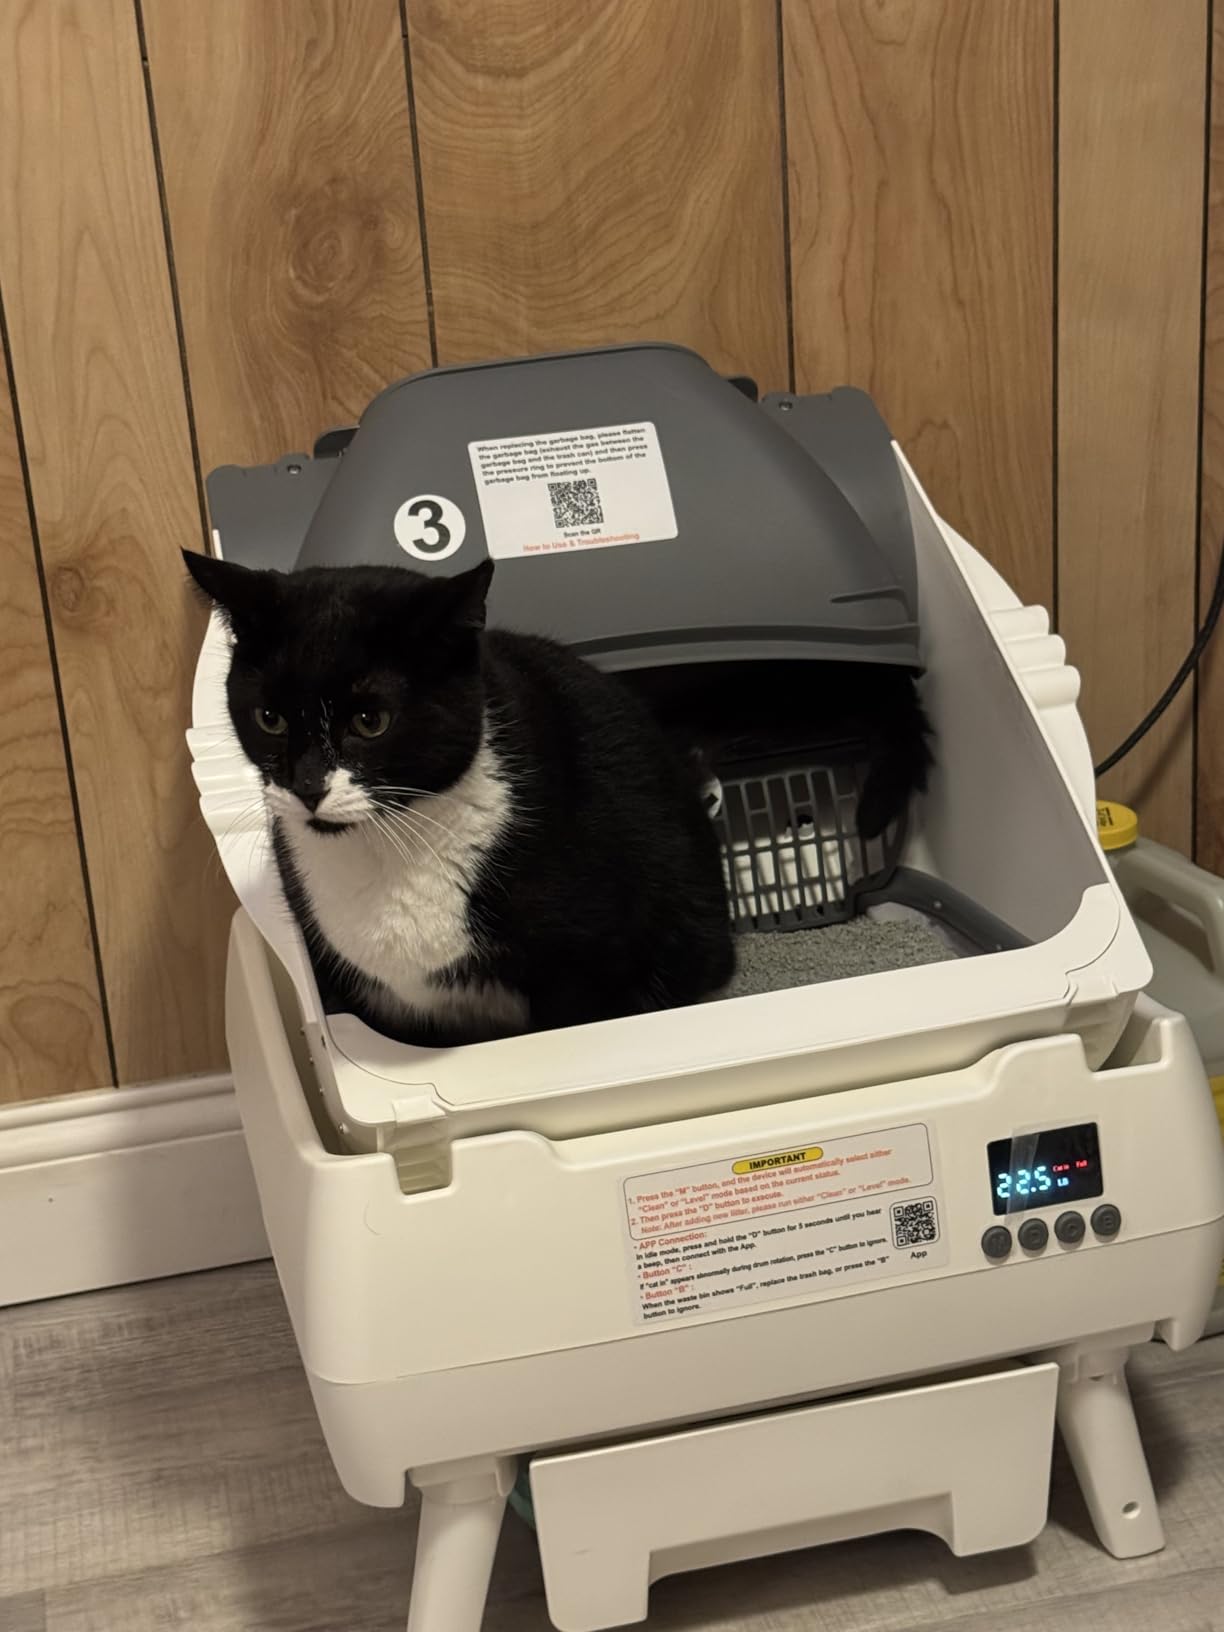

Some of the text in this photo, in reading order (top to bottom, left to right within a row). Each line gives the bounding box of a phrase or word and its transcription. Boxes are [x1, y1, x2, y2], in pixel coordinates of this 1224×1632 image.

[492, 451, 522, 460] garbage
[600, 438, 631, 446] between
[548, 436, 578, 445] garbage
[597, 431, 621, 439] please
[480, 460, 511, 469] garbage
[627, 444, 648, 452] press
[496, 467, 528, 475] pressure
[555, 460, 583, 468] prevent
[597, 455, 624, 463] bottom
[484, 477, 514, 485] garbage
[408, 500, 451, 554] 3
[749, 1152, 805, 1169] IMPORTANT
[636, 1194, 659, 1203] Press
[721, 1177, 736, 1187] and
[737, 1176, 750, 1184] the
[751, 1171, 777, 1181] device
[778, 1167, 792, 1176] will
[793, 1158, 844, 1173] automatically
[845, 1153, 868, 1163] select
[869, 1149, 891, 1158] either
[711, 1190, 733, 1199] mode
[734, 1184, 758, 1195] based
[759, 1182, 770, 1190] on
[771, 1180, 784, 1188] the
[785, 1174, 813, 1185] current
[996, 1165, 1052, 1198] 22.5
[639, 1215, 660, 1223] Then
[661, 1210, 683, 1220] press
[684, 1207, 698, 1215] the
[714, 1199, 740, 1209] button
[751, 1191, 783, 1202] execute.
[663, 1220, 682, 1230] After
[684, 1215, 711, 1225] adding
[751, 1203, 776, 1213] please
[792, 1195, 814, 1205] either
[682, 1243, 702, 1253] press
[703, 1239, 717, 1247] and
[718, 1236, 734, 1244] hold
[762, 1227, 785, 1236] button
[804, 1218, 833, 1228] seconds
[834, 1213, 850, 1222] until
[852, 1212, 865, 1220] you
[866, 1208, 881, 1216] hear
[639, 1239, 656, 1250] APP
[910, 1250, 927, 1259] App
[643, 1260, 663, 1268] beep,
[681, 1250, 710, 1261] connect
[711, 1247, 726, 1255] with
[670, 1275, 695, 1284] appears
[696, 1267, 730, 1279] abnormally
[731, 1264, 752, 1272] during
[752, 1260, 769, 1268] drum
[796, 1252, 814, 1261] press
[838, 1243, 858, 1251] button
[642, 1268, 670, 1279] Button
[642, 1302, 662, 1310] When
[676, 1295, 697, 1303] waste
[712, 1288, 734, 1296] shows
[759, 1278, 785, 1287] replace
[799, 1271, 817, 1279] trash
[843, 1262, 863, 1271] press
[645, 1289, 672, 1300] Button
[643, 1310, 666, 1319] button
